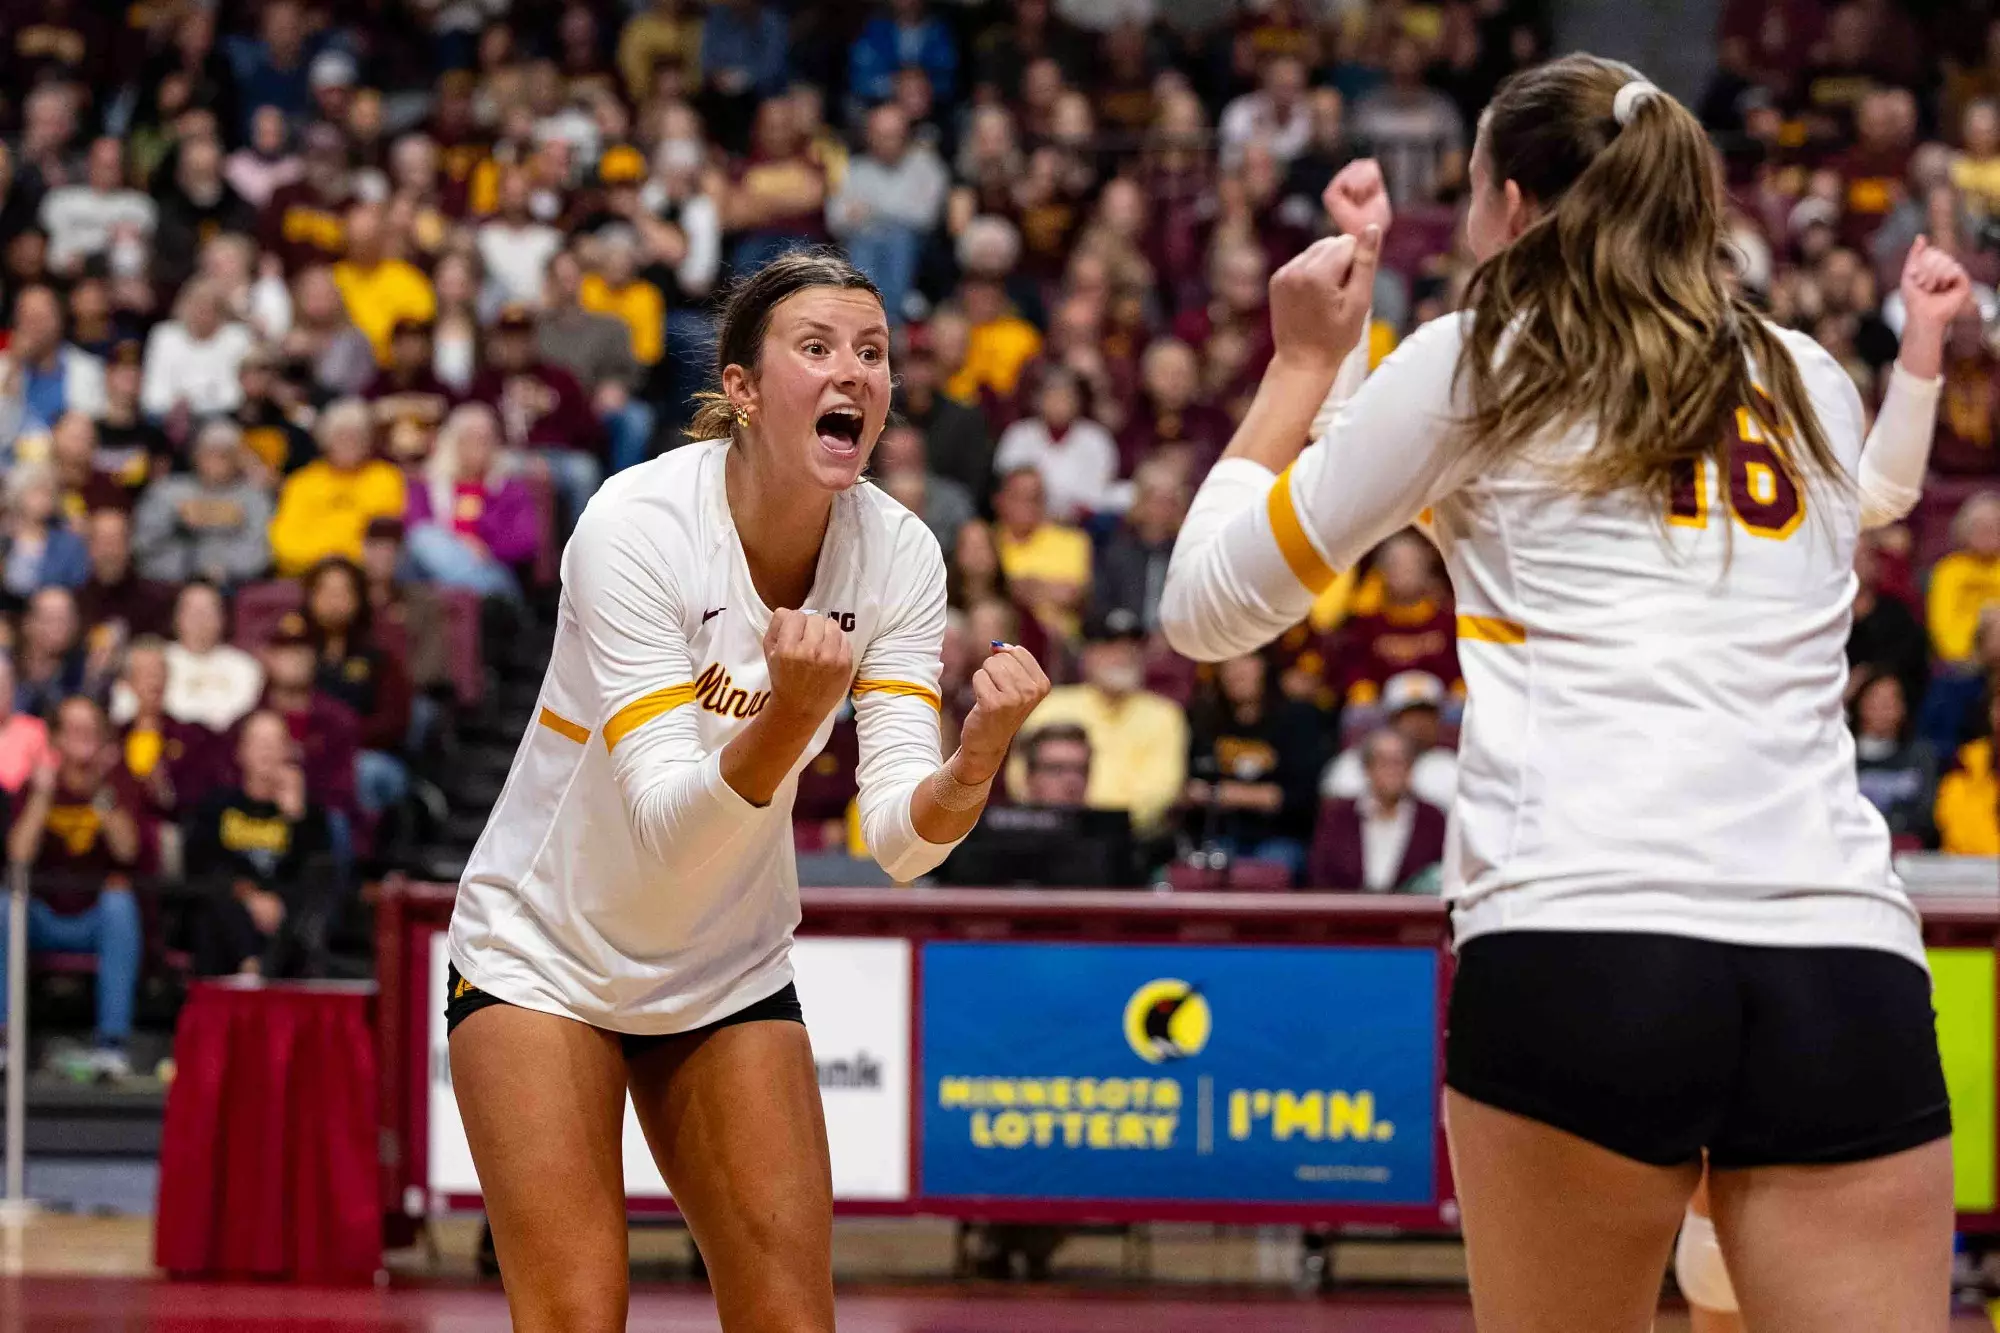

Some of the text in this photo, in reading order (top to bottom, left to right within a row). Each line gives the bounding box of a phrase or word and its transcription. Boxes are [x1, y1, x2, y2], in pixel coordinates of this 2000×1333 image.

[939, 1077, 1181, 1110] MINNESOTA
[969, 1110, 1179, 1149] LOTTERY
[1228, 1089, 1394, 1143] I'MN.
